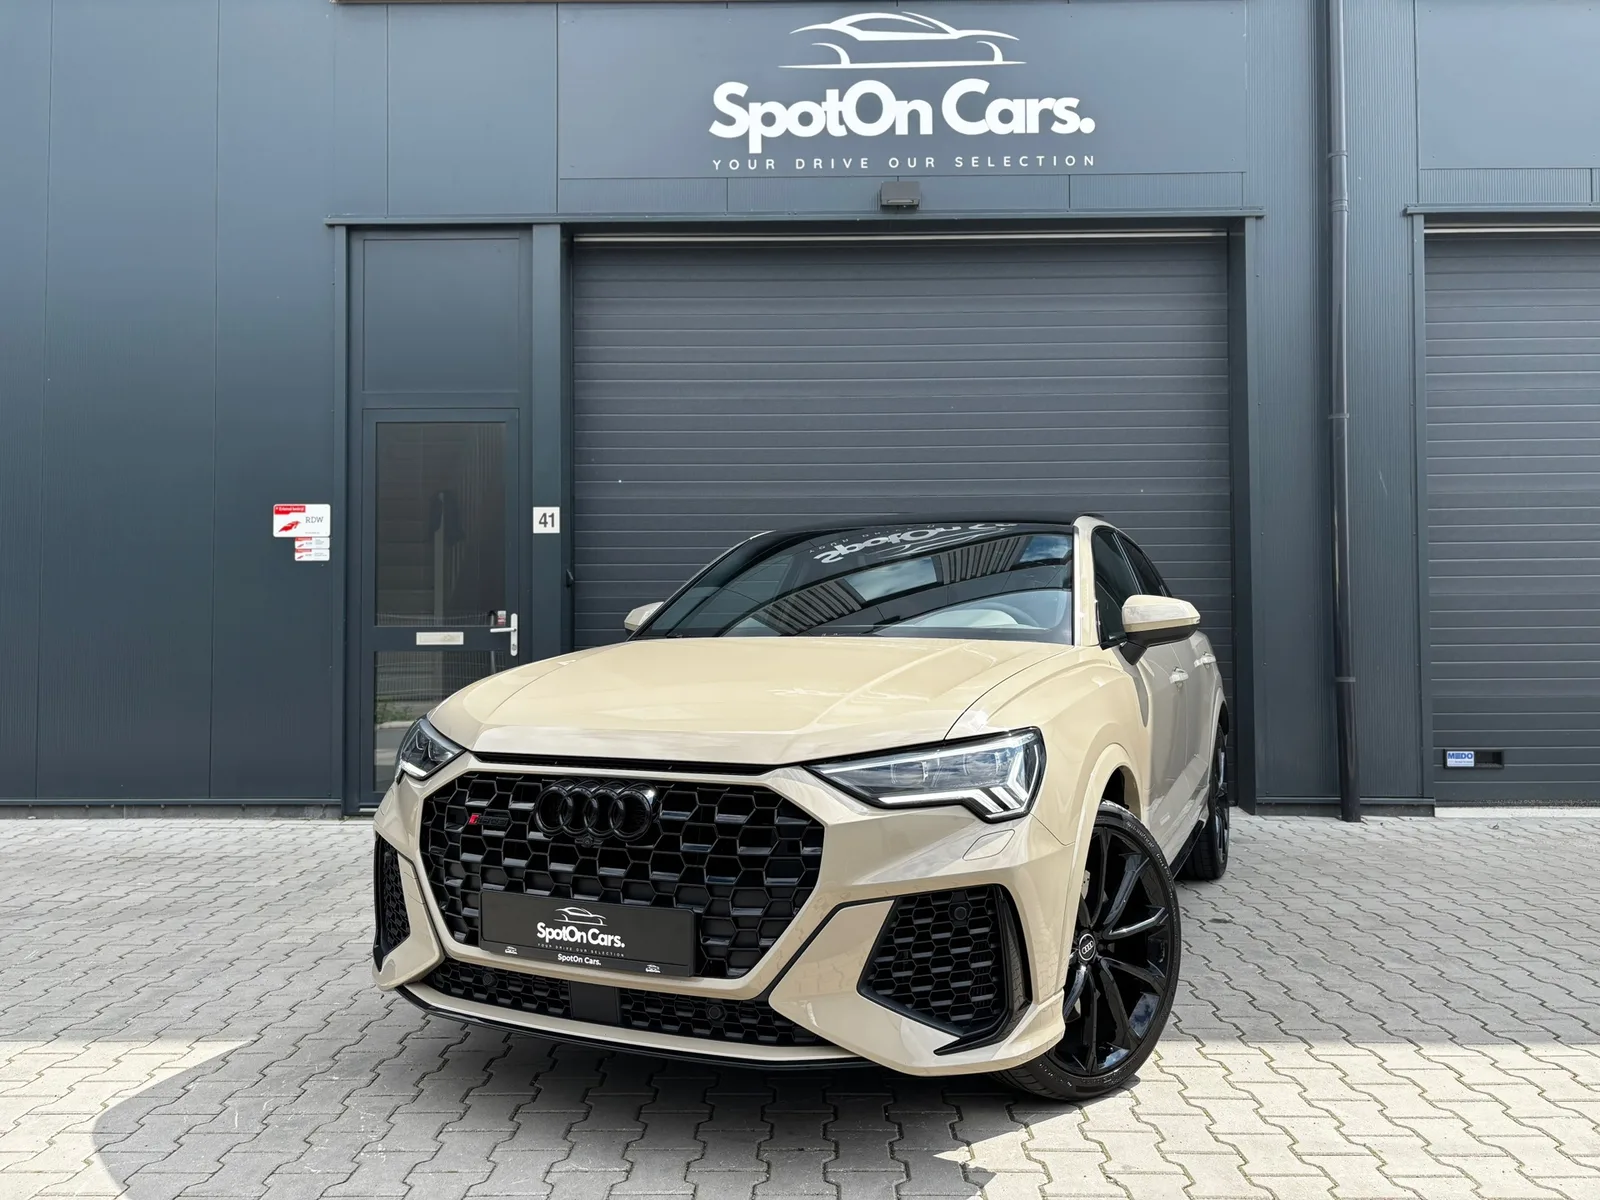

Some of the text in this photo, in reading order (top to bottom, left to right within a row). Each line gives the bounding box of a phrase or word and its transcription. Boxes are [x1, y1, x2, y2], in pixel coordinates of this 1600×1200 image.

[708, 78, 1096, 154] SpotOn Cars.
[712, 155, 1095, 171] YOUR DRIVE OUR SELECTION
[305, 516, 324, 524] RDW
[538, 512, 555, 528] 41
[536, 922, 626, 948] SpotOn Cars.
[557, 953, 602, 966] SpotOn Cars.
